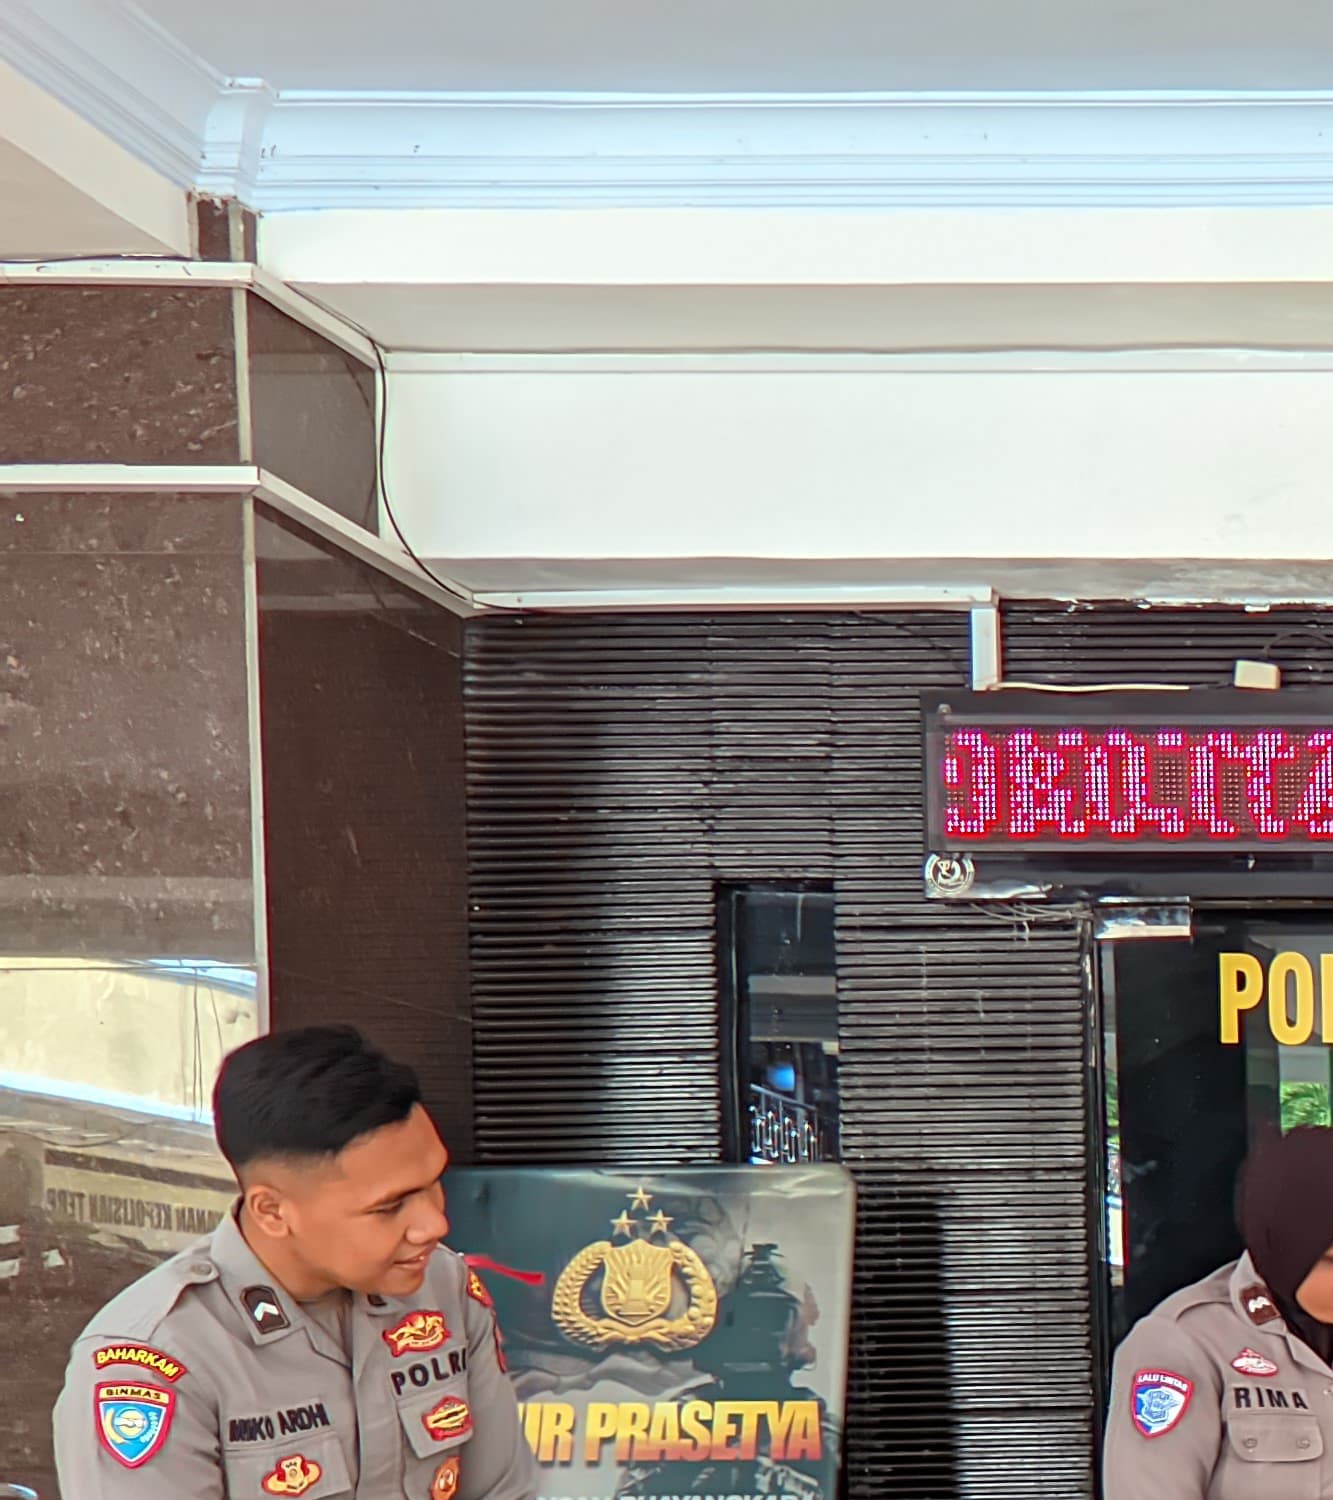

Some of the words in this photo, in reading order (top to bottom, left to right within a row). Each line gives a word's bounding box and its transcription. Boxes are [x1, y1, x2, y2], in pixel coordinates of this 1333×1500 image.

[97, 1348, 179, 1378] BAHARKAM
[390, 1348, 467, 1395] POLRI
[1234, 1386, 1308, 1410] RIMA
[277, 1403, 330, 1435] ARDHI
[585, 1401, 823, 1461] PRASETYA
